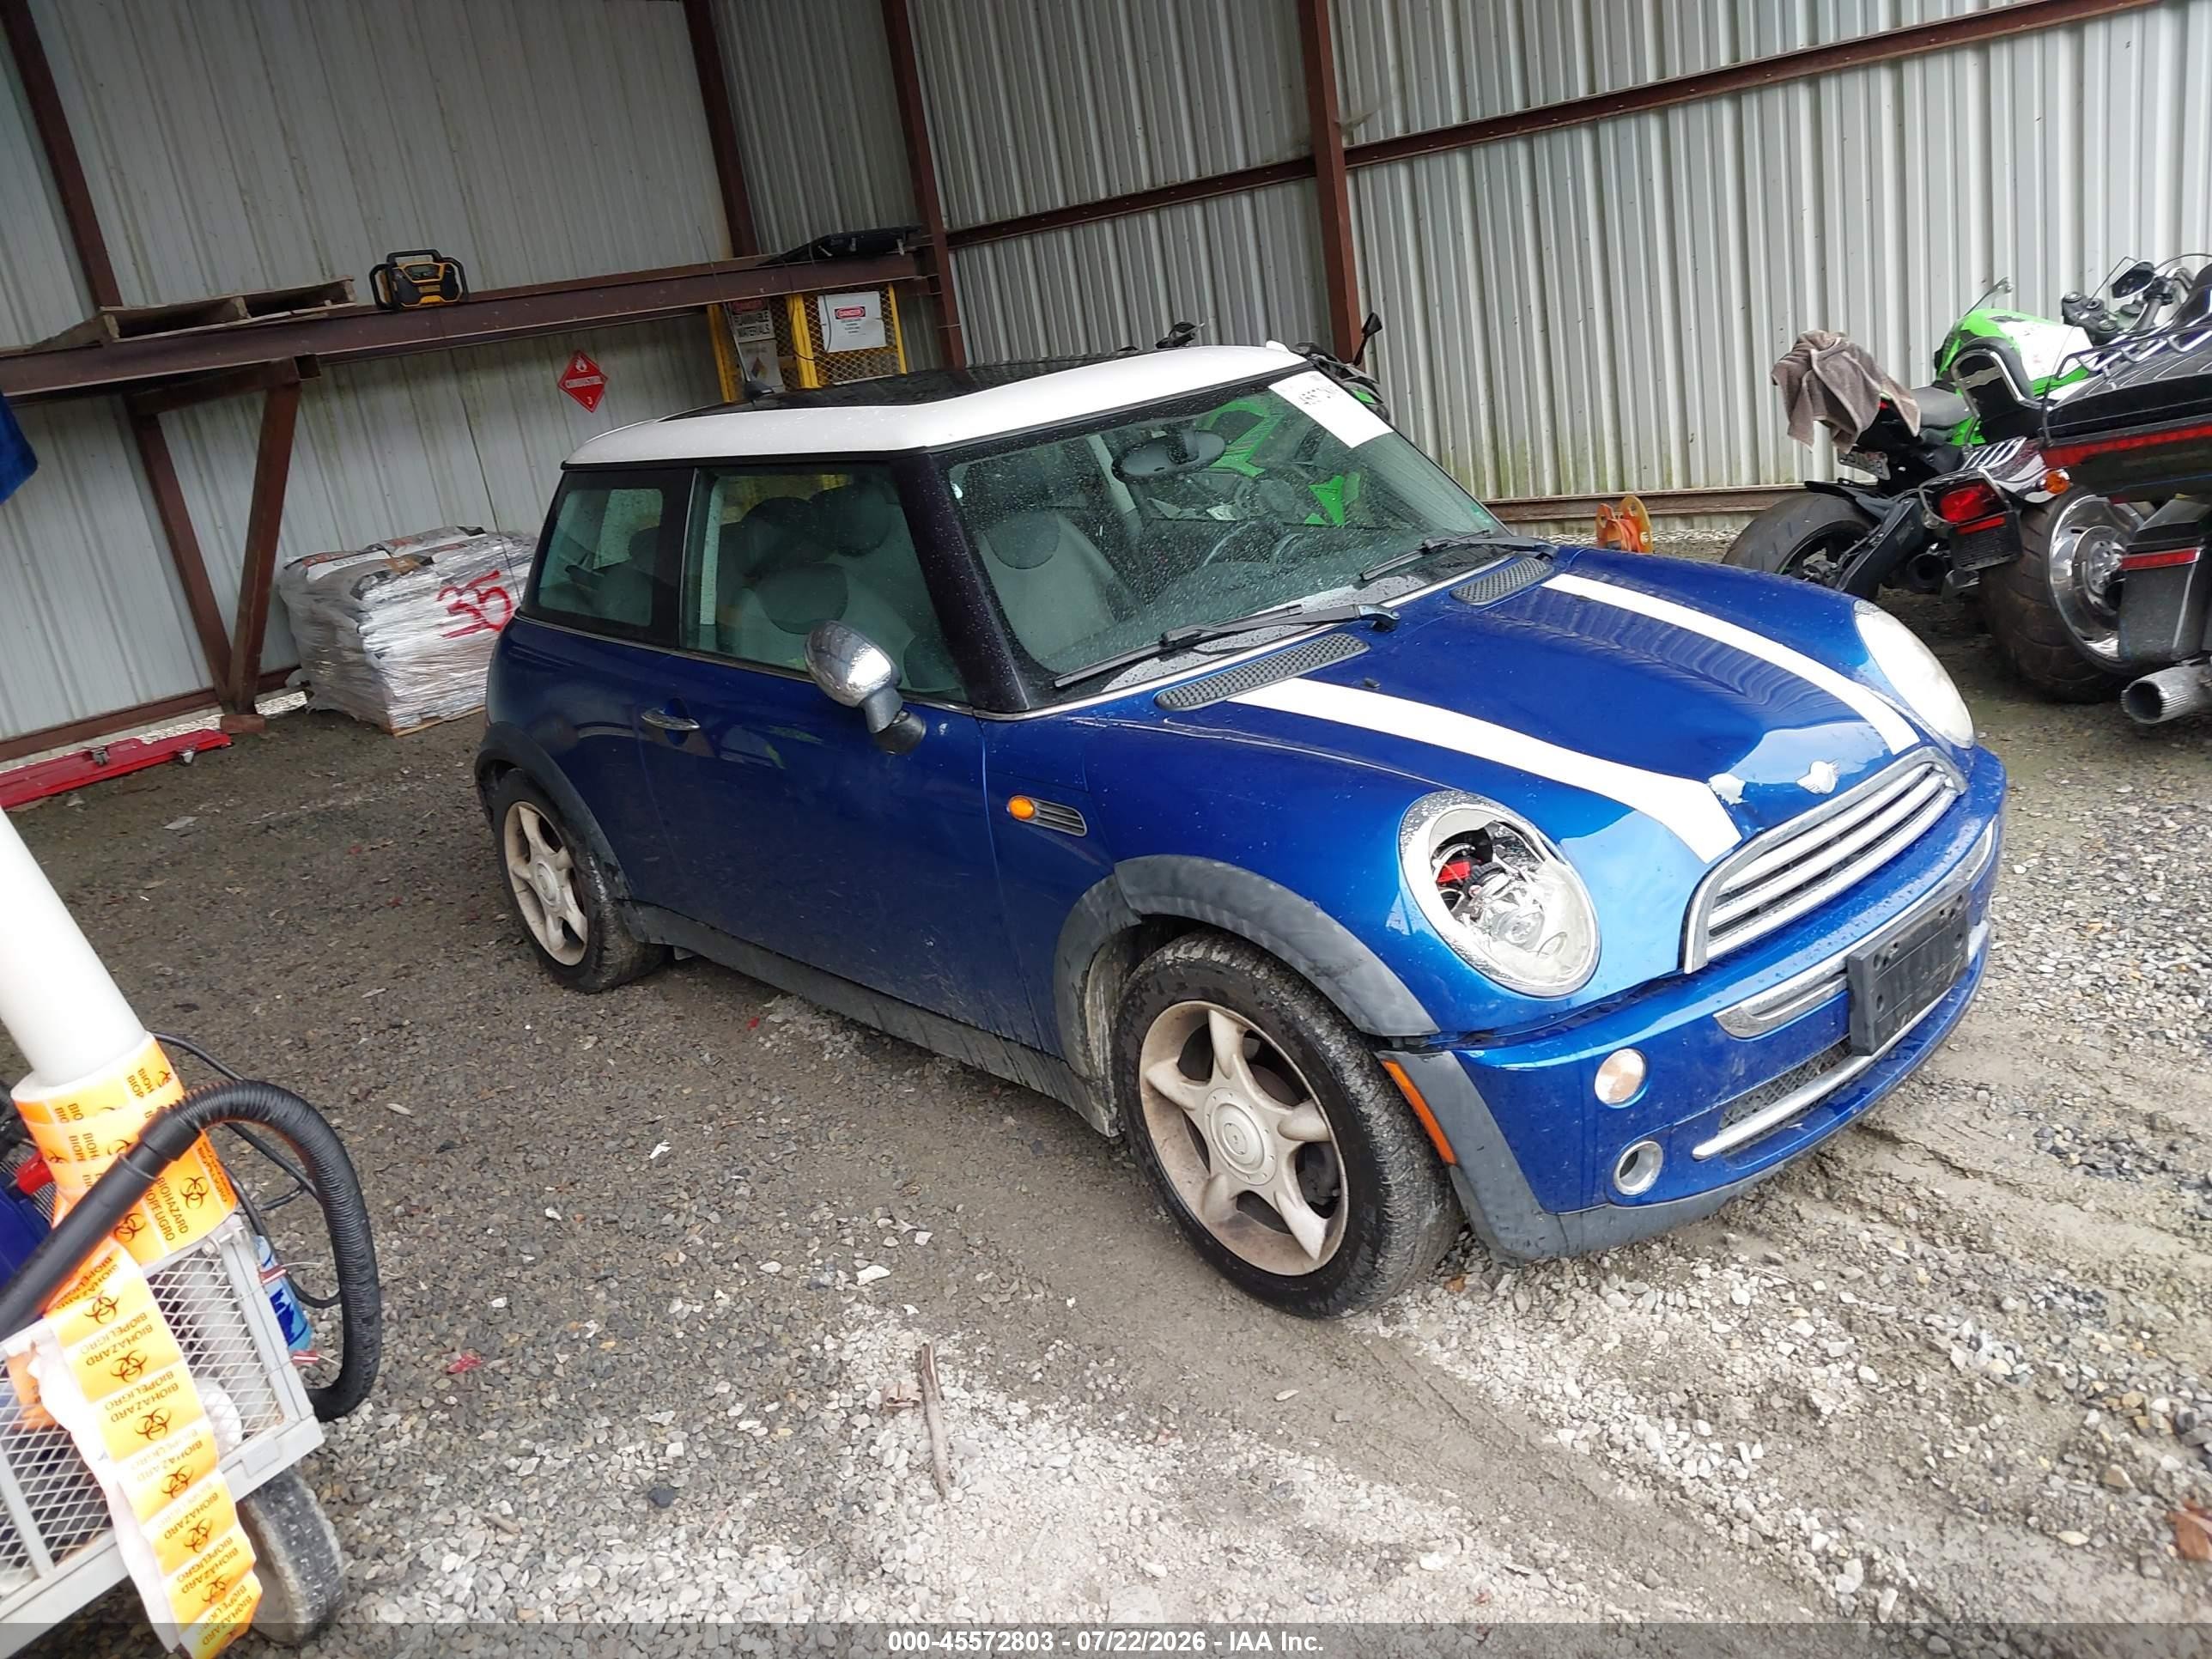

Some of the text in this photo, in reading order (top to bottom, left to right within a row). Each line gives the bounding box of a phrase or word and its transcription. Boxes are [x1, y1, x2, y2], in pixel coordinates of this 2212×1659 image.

[145, 1188, 175, 1242] IOPELIGRO
[156, 1176, 189, 1235] BIOHAZARD
[80, 1312, 149, 1355] BIOPELIGRO
[86, 1324, 154, 1367] BIOHAZARD
[105, 1370, 174, 1412] BIOPELIGRO
[110, 1382, 179, 1423] BIOHAZARD
[164, 1492, 219, 1540] BIOHAZARD
[177, 1536, 234, 1583] BIOPELIGRO
[181, 1547, 240, 1595] BIOHAZARD
[202, 1595, 253, 1646] BIOHAZARD
